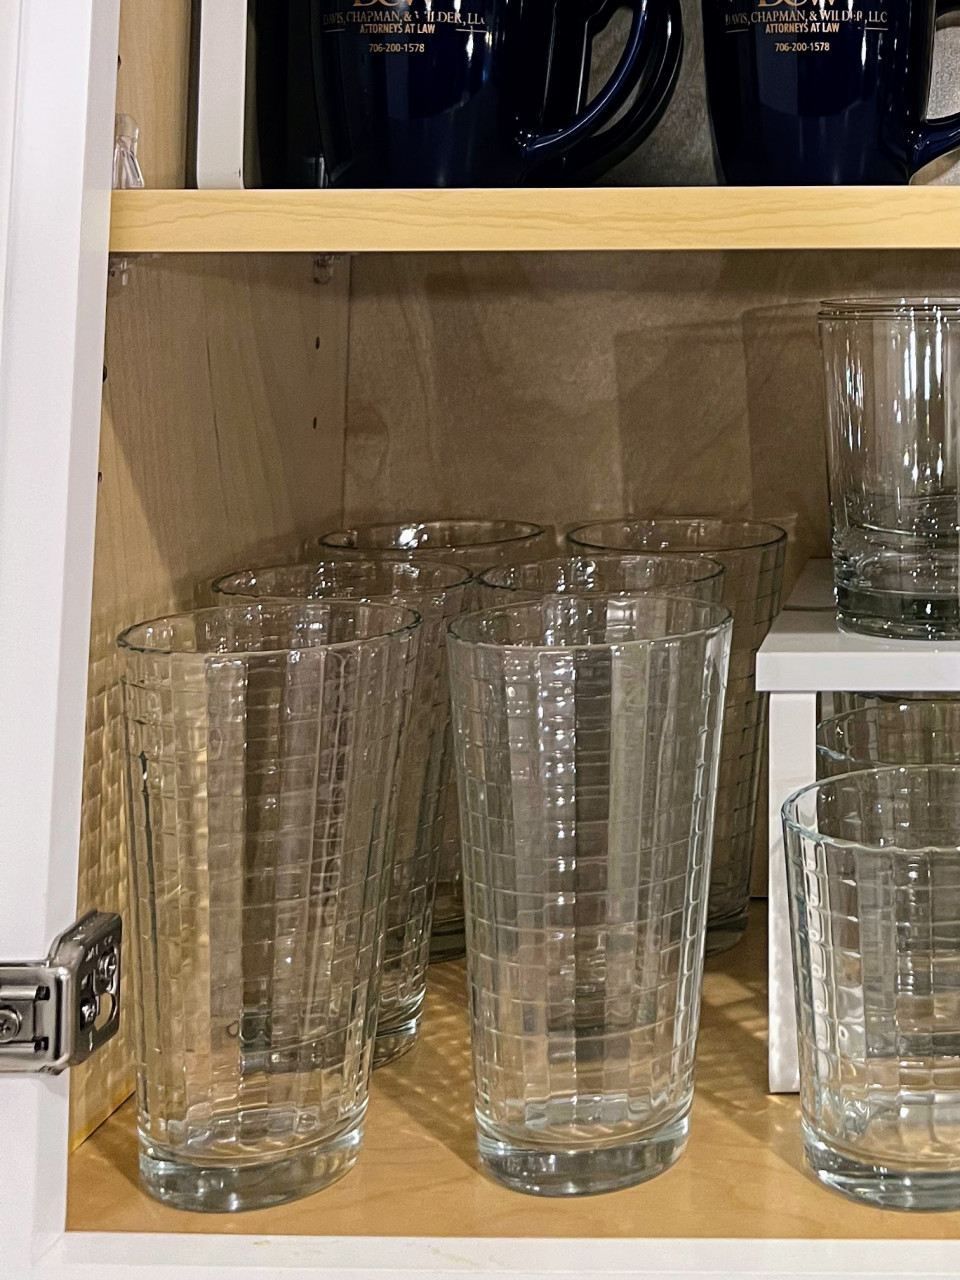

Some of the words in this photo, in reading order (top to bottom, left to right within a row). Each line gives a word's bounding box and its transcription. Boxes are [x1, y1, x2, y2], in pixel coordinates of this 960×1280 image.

[347, 10, 403, 24] CHAPMAN,
[403, 12, 412, 22] &
[414, 10, 466, 26] ILDER,
[751, 10, 809, 24] CHAPMAN,
[809, 10, 817, 21] &
[868, 11, 888, 23] LLC
[360, 23, 403, 34] ATTORNEYS
[404, 23, 415, 34] AT
[417, 23, 436, 34] LAW
[765, 23, 809, 34] ATTORNEYS
[810, 23, 820, 33] AT
[822, 23, 840, 33] LAW
[368, 43, 425, 53] 706-200-1578
[774, 42, 830, 52] 706-200-1578
